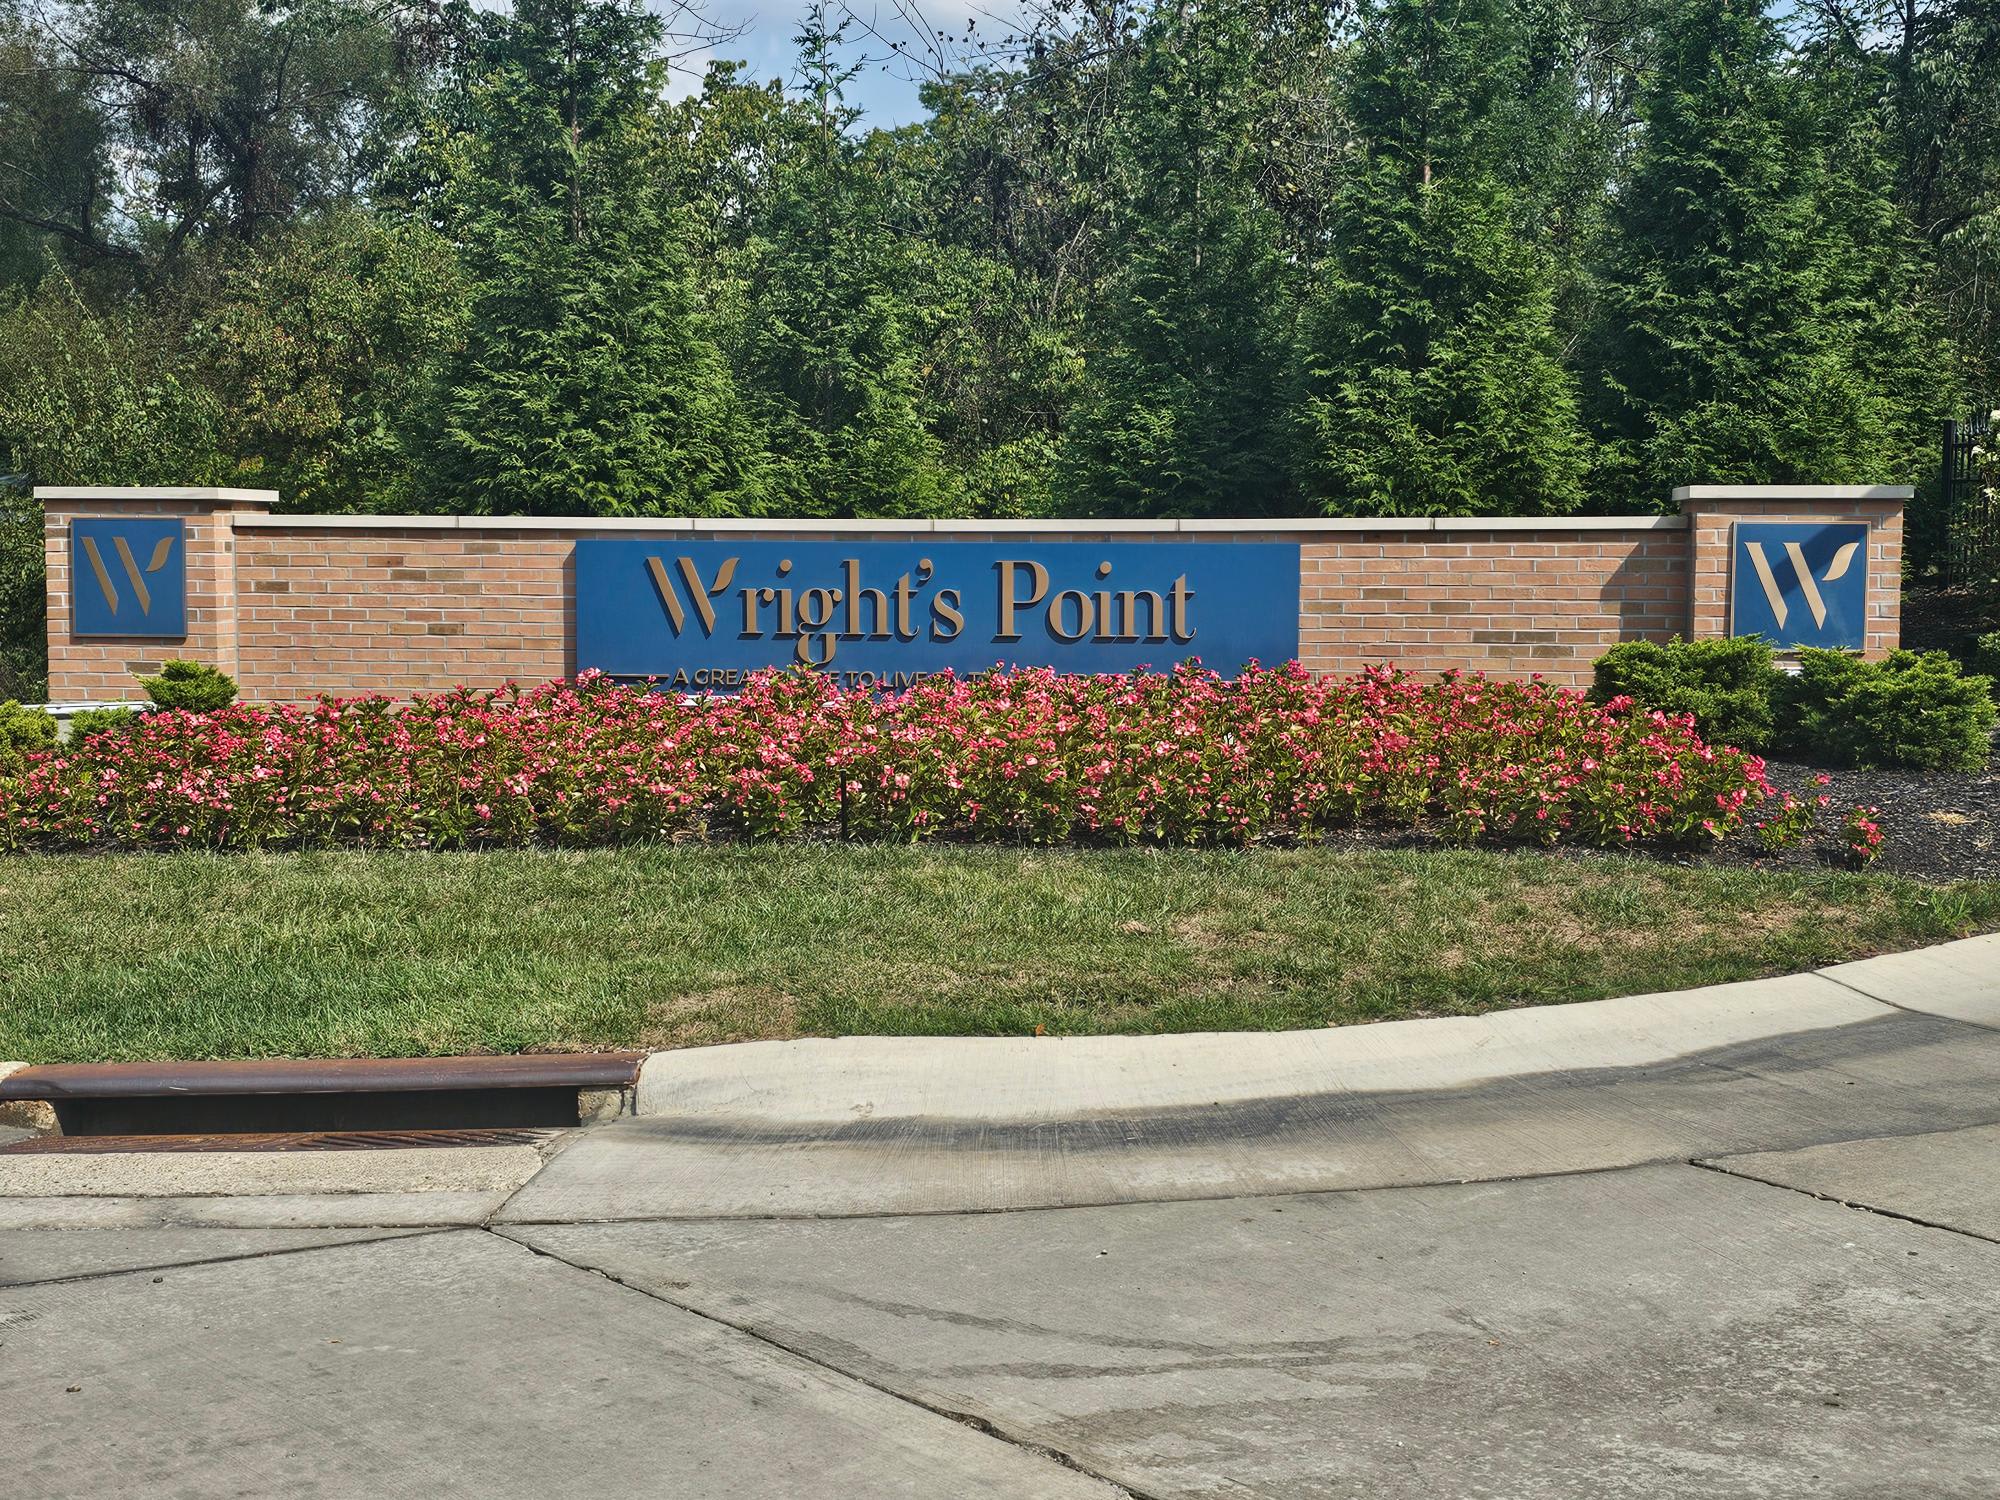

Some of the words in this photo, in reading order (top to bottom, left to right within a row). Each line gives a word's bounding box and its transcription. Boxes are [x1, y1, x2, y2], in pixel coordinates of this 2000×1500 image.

[644, 556, 965, 664] Wright's
[994, 560, 1197, 639] Point
[673, 667, 689, 684] A
[846, 670, 876, 687] TO
